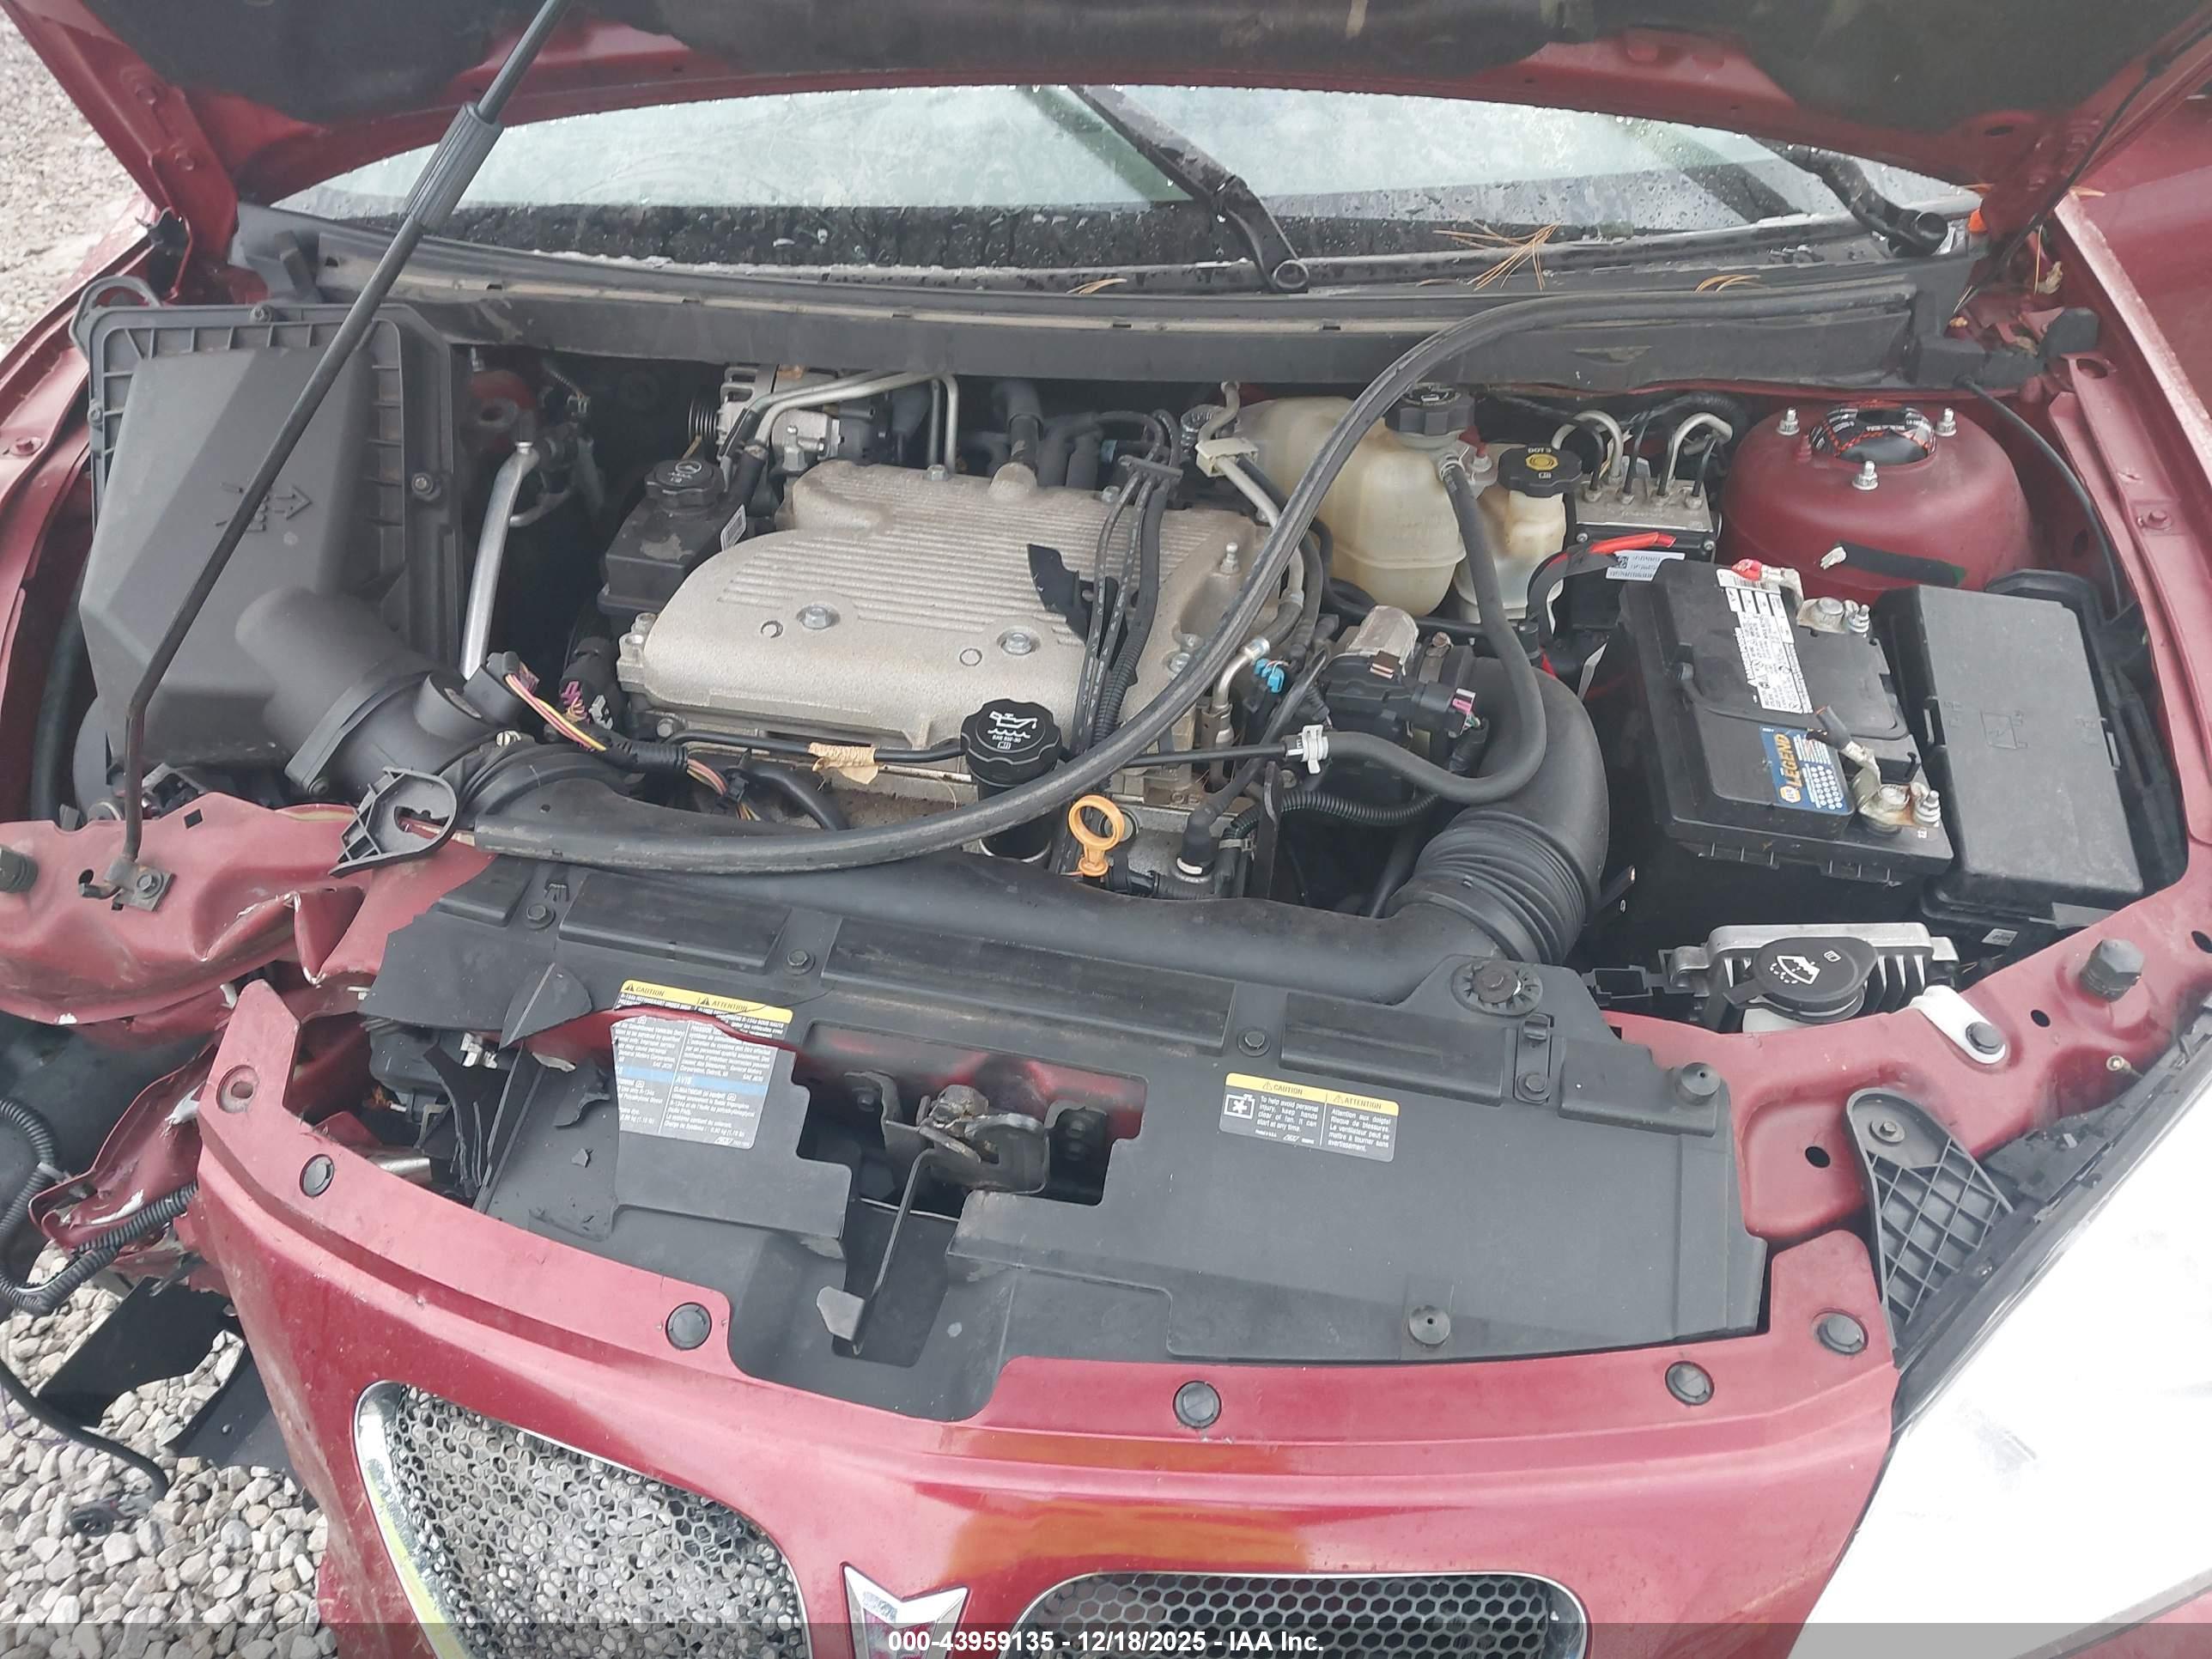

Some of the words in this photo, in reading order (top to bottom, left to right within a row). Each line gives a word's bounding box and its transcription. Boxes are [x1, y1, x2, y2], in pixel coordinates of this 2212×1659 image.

[1773, 733, 1802, 787] LEGEND
[635, 987, 665, 997] CAUTION
[711, 1000, 748, 1012] ATTENTION
[1273, 1084, 1304, 1096] CAUTION
[1267, 1097, 1279, 1106] help
[1280, 1100, 1296, 1109] avoid
[1296, 1103, 1319, 1113] personal
[1345, 1097, 1382, 1109] ATTENTION
[1258, 1110, 1273, 1119] clear
[1281, 1108, 1296, 1116] keep
[1300, 1110, 1318, 1120] hands
[1331, 1108, 1357, 1119] Attention
[1256, 1119, 1270, 1127] start
[1277, 1122, 1287, 1131] any
[1331, 1115, 1350, 1125] Risque
